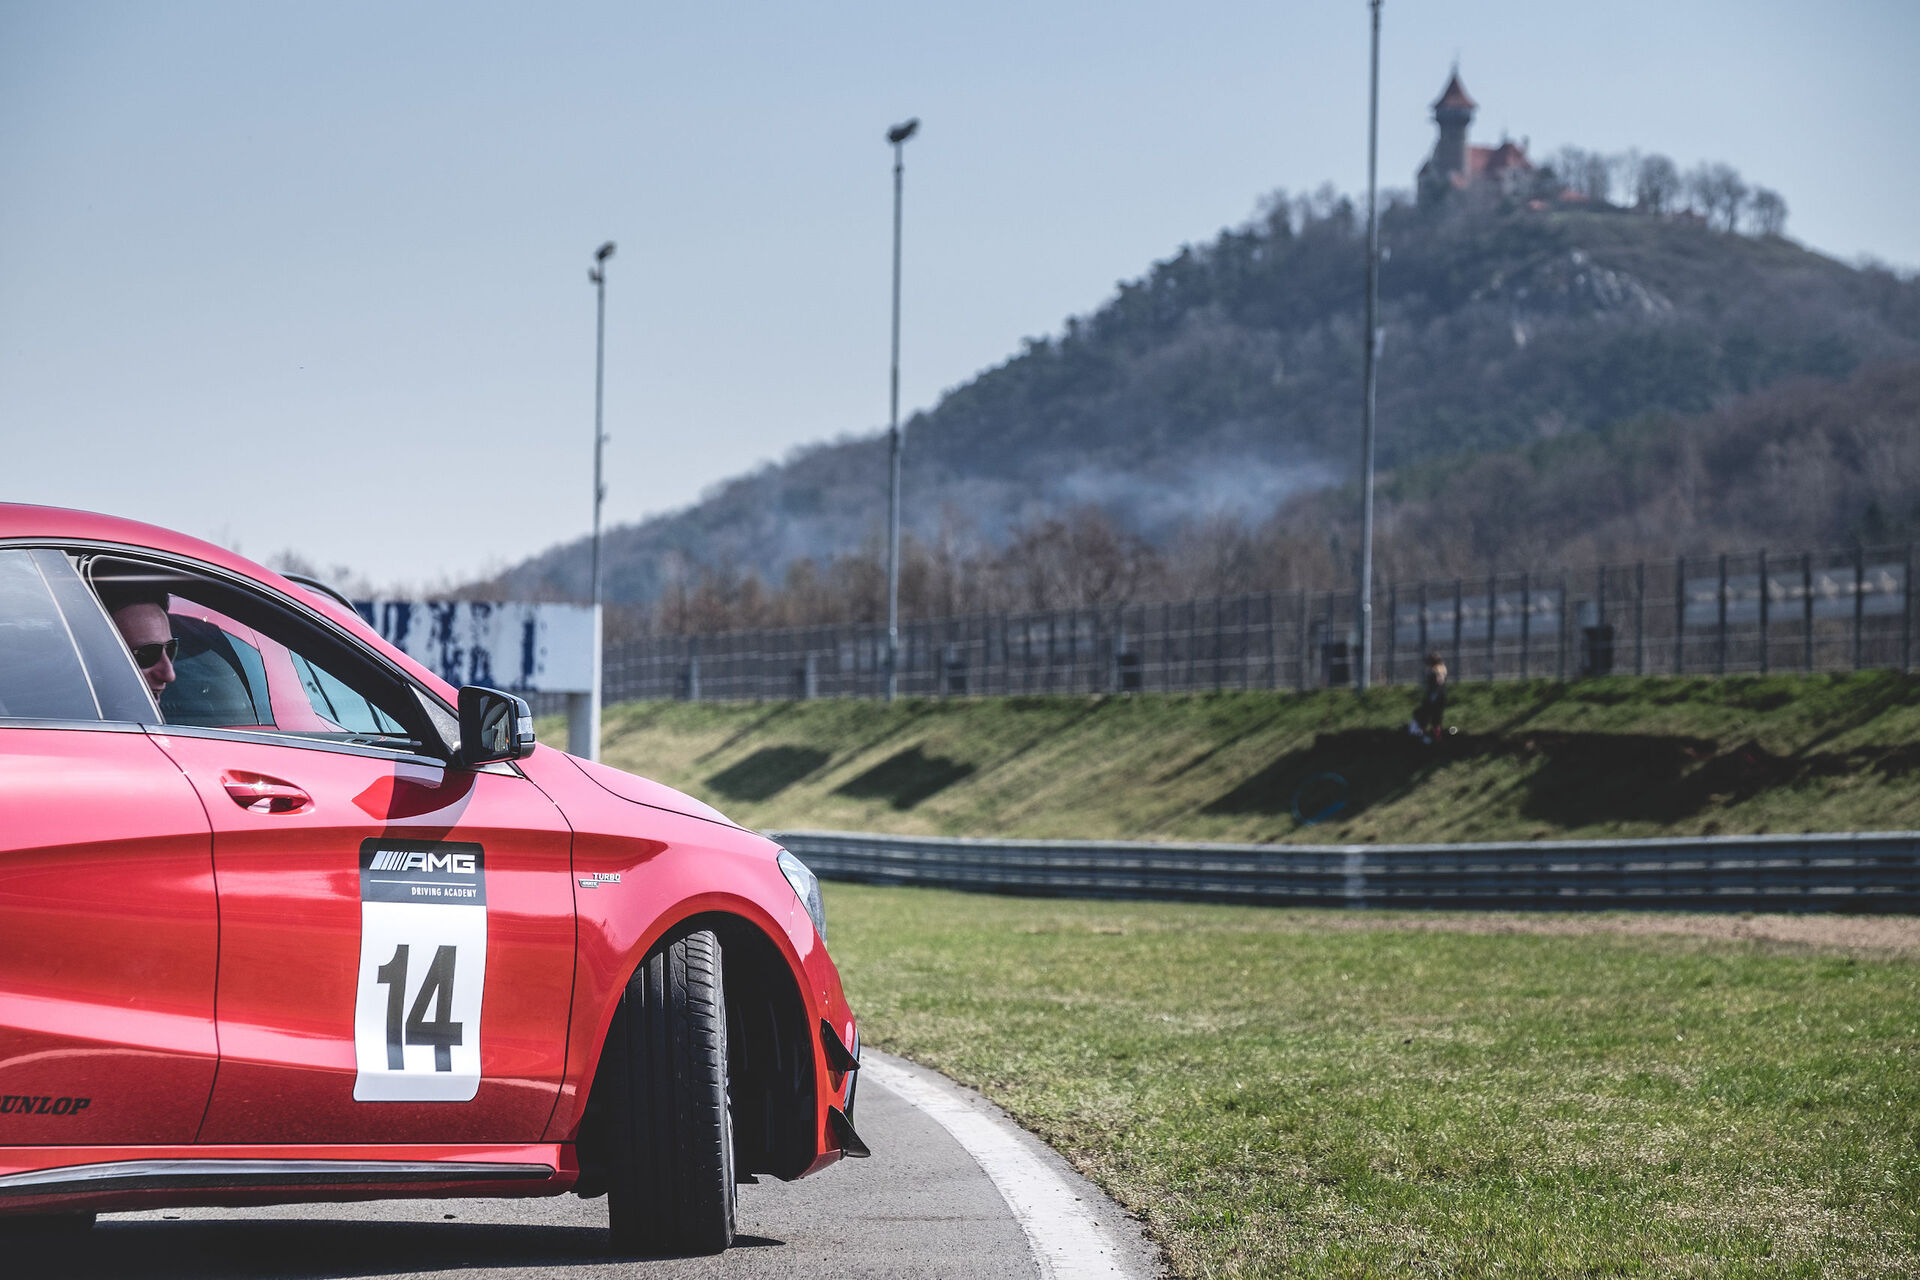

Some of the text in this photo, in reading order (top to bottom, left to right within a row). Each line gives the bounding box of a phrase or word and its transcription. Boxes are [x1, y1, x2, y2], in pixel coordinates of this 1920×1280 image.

[401, 851, 476, 874] AMG
[592, 872, 621, 881] TURBO
[411, 886, 477, 898] DRIVING ACADEMY
[377, 944, 463, 1072] 14
[0, 1095, 91, 1115] UNLOP
